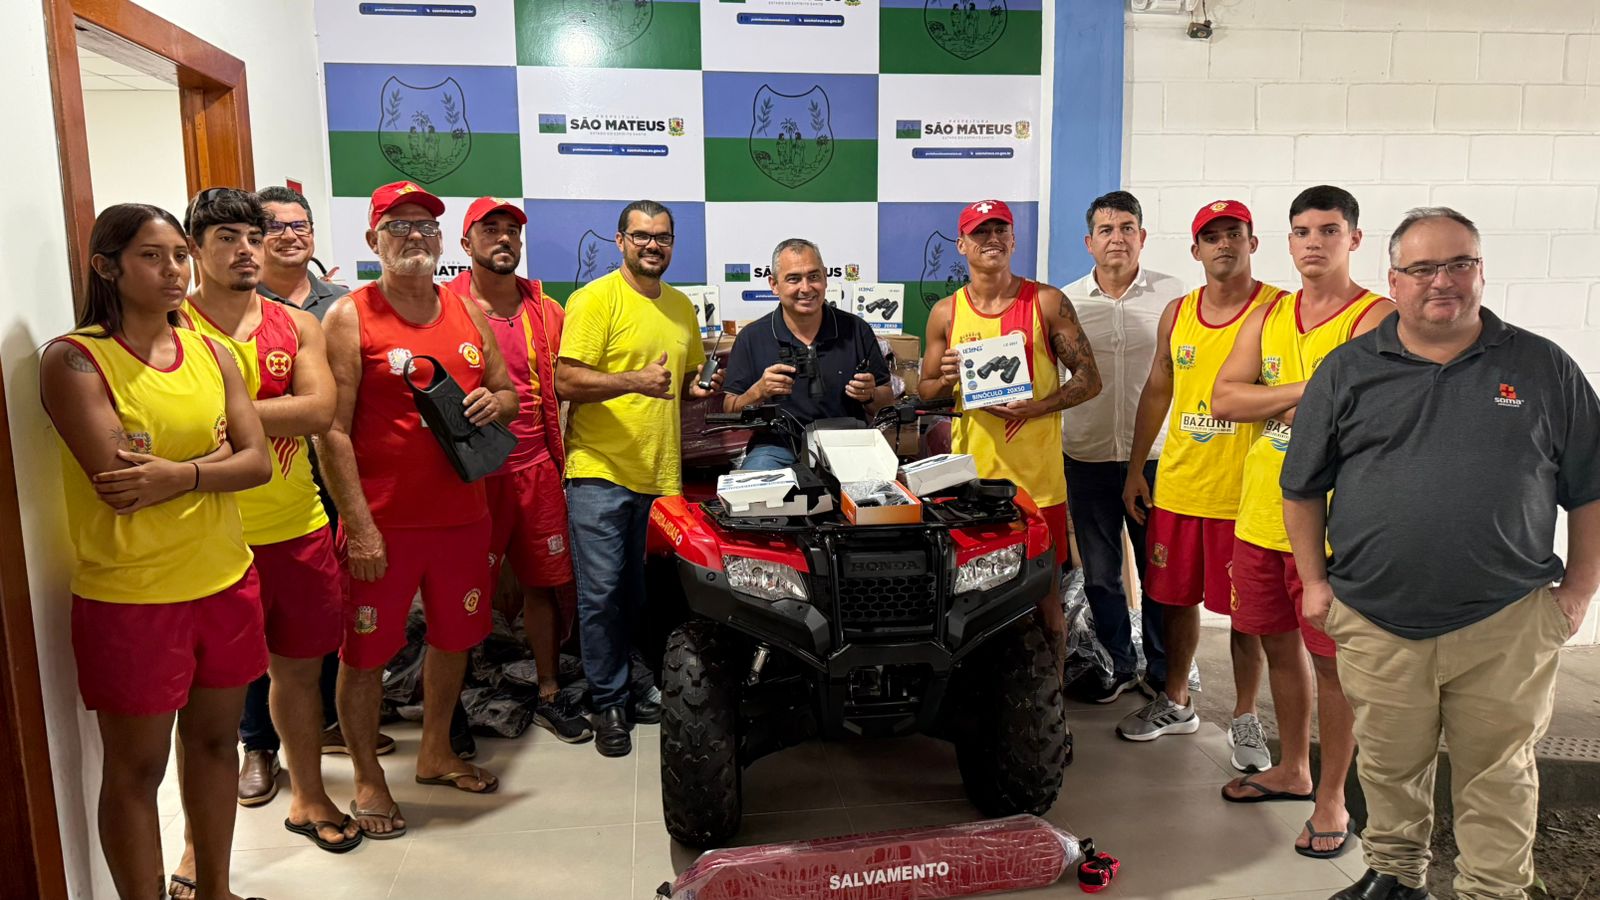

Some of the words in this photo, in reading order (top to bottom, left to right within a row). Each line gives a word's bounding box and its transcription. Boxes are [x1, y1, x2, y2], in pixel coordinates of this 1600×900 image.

[570, 117, 602, 131] SÃO
[605, 120, 666, 131] MATEUS
[924, 122, 954, 135] SÃO
[957, 124, 1013, 135] MATEUS
[971, 388, 1003, 401] BINÓCULO
[1006, 385, 1026, 395] 20X50
[850, 560, 921, 573] HONDA
[829, 861, 949, 890] SALVAMENTO
